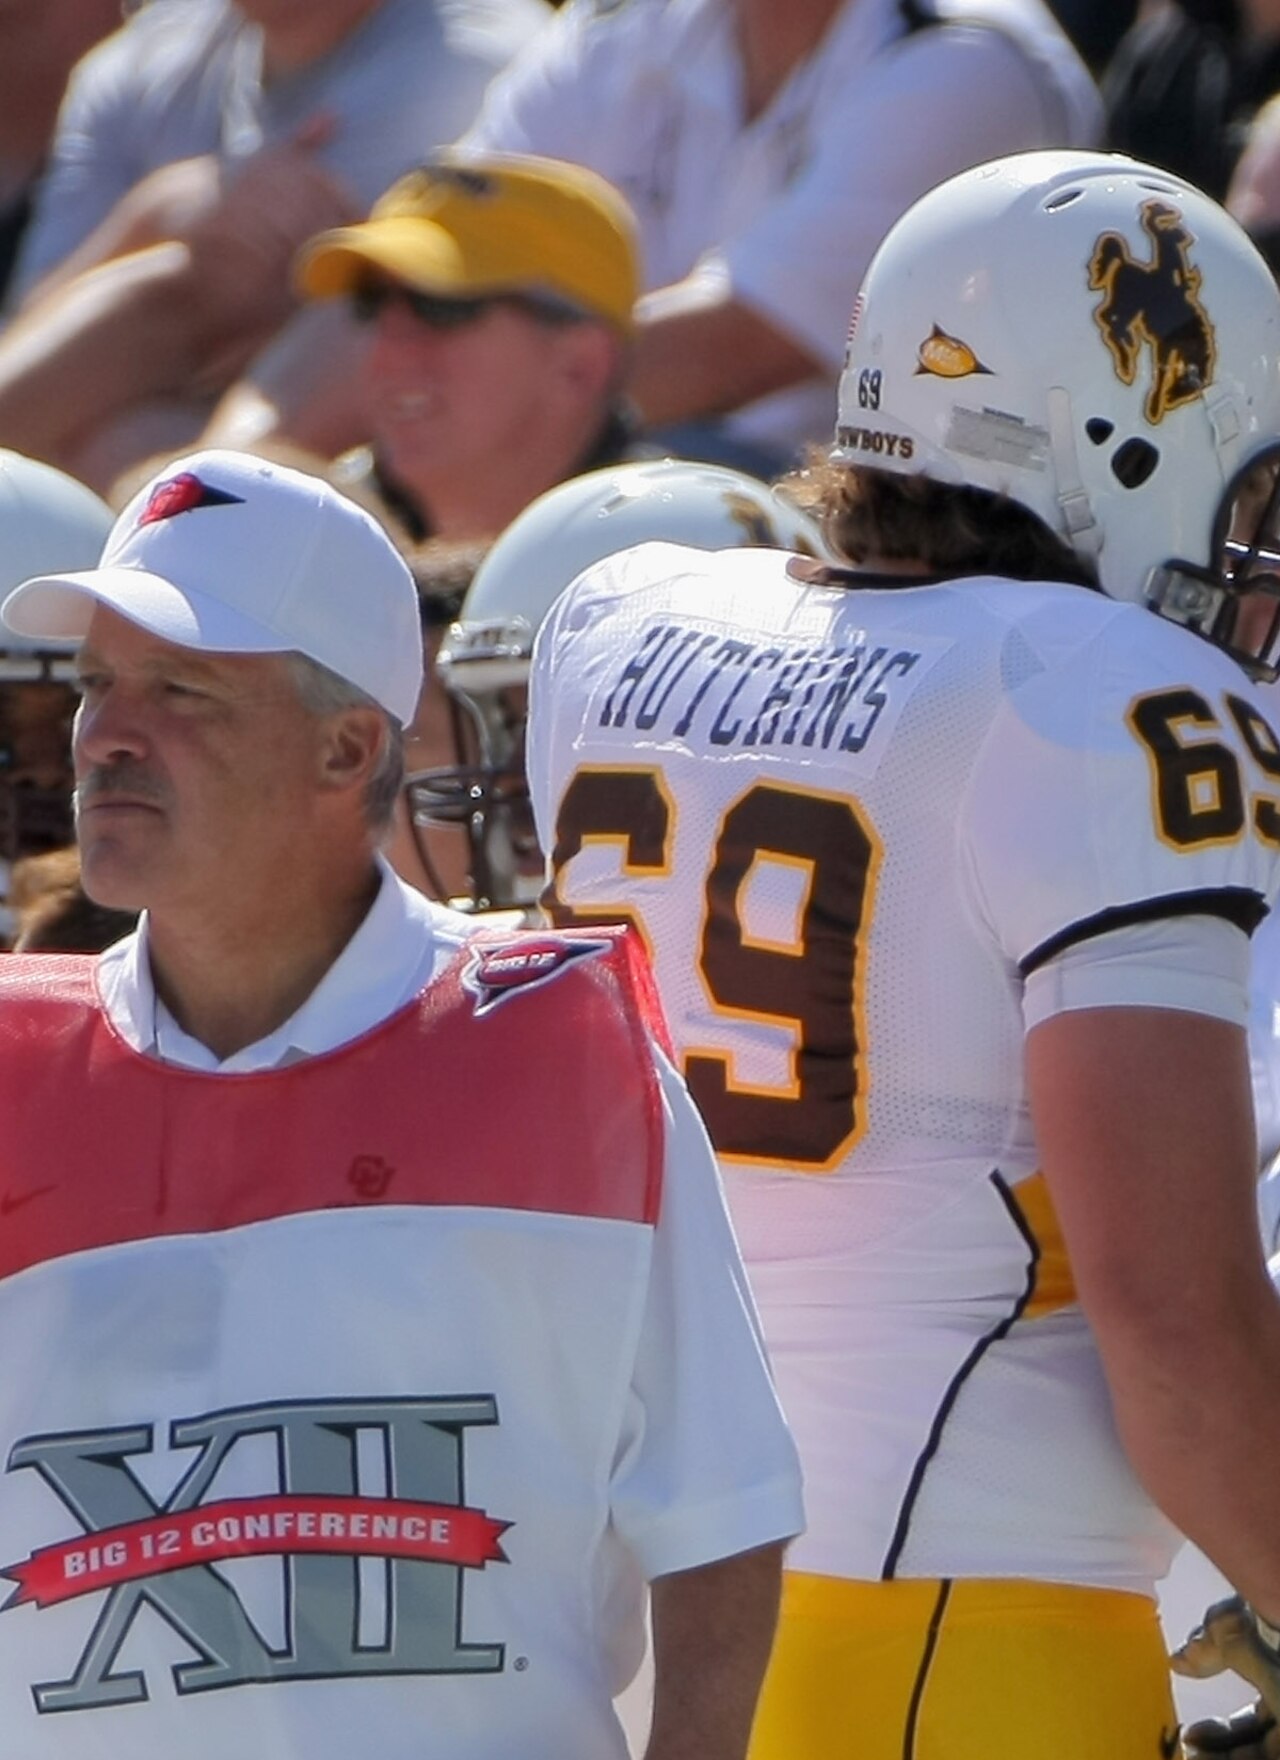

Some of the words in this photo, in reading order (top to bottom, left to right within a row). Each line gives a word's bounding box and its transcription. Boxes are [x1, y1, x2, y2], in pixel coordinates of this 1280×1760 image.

[858, 368, 882, 411] 69
[599, 625, 922, 753] HUTCHINS
[4, 1393, 506, 1714] XII
[63, 1542, 129, 1579] BIG
[140, 1529, 182, 1559] 12
[190, 1511, 452, 1547] CONFERENCE
